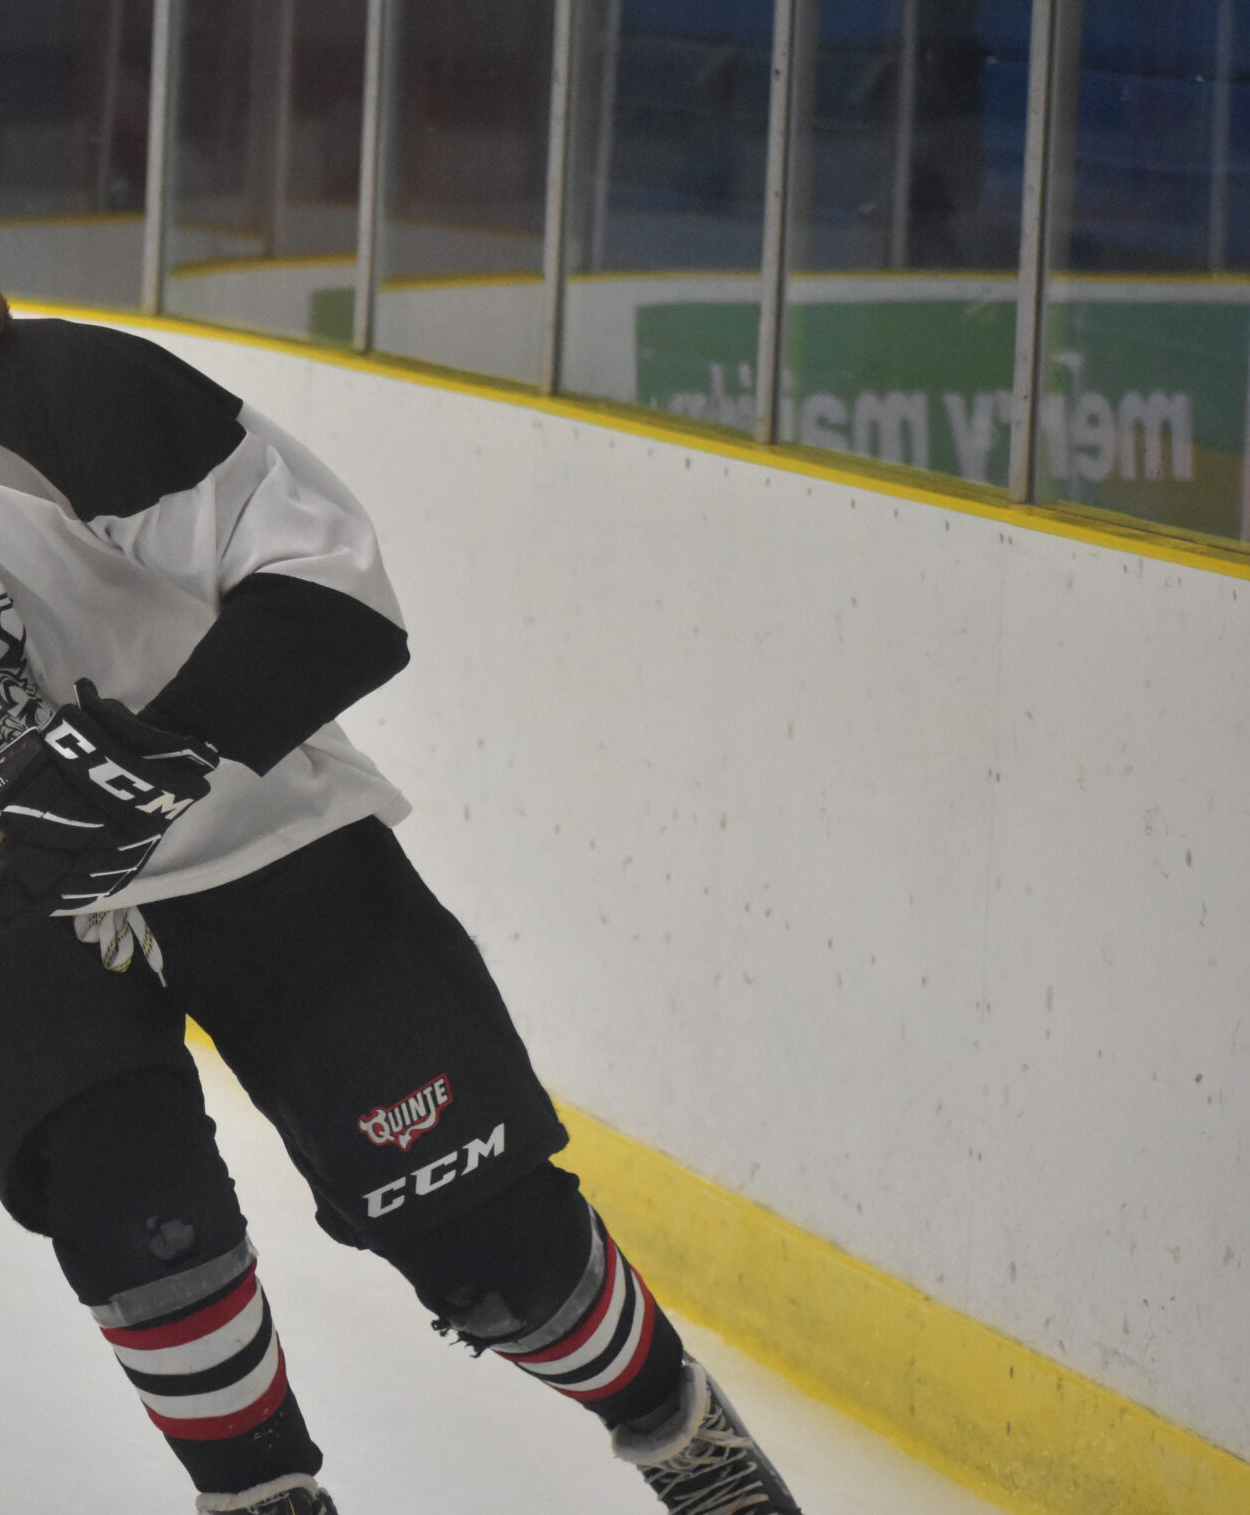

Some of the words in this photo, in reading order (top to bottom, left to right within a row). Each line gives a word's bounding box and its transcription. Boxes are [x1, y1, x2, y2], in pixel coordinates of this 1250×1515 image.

[44, 718, 195, 821] CCM
[359, 1077, 449, 1150] QUINTE
[362, 1122, 505, 1219] CCM
